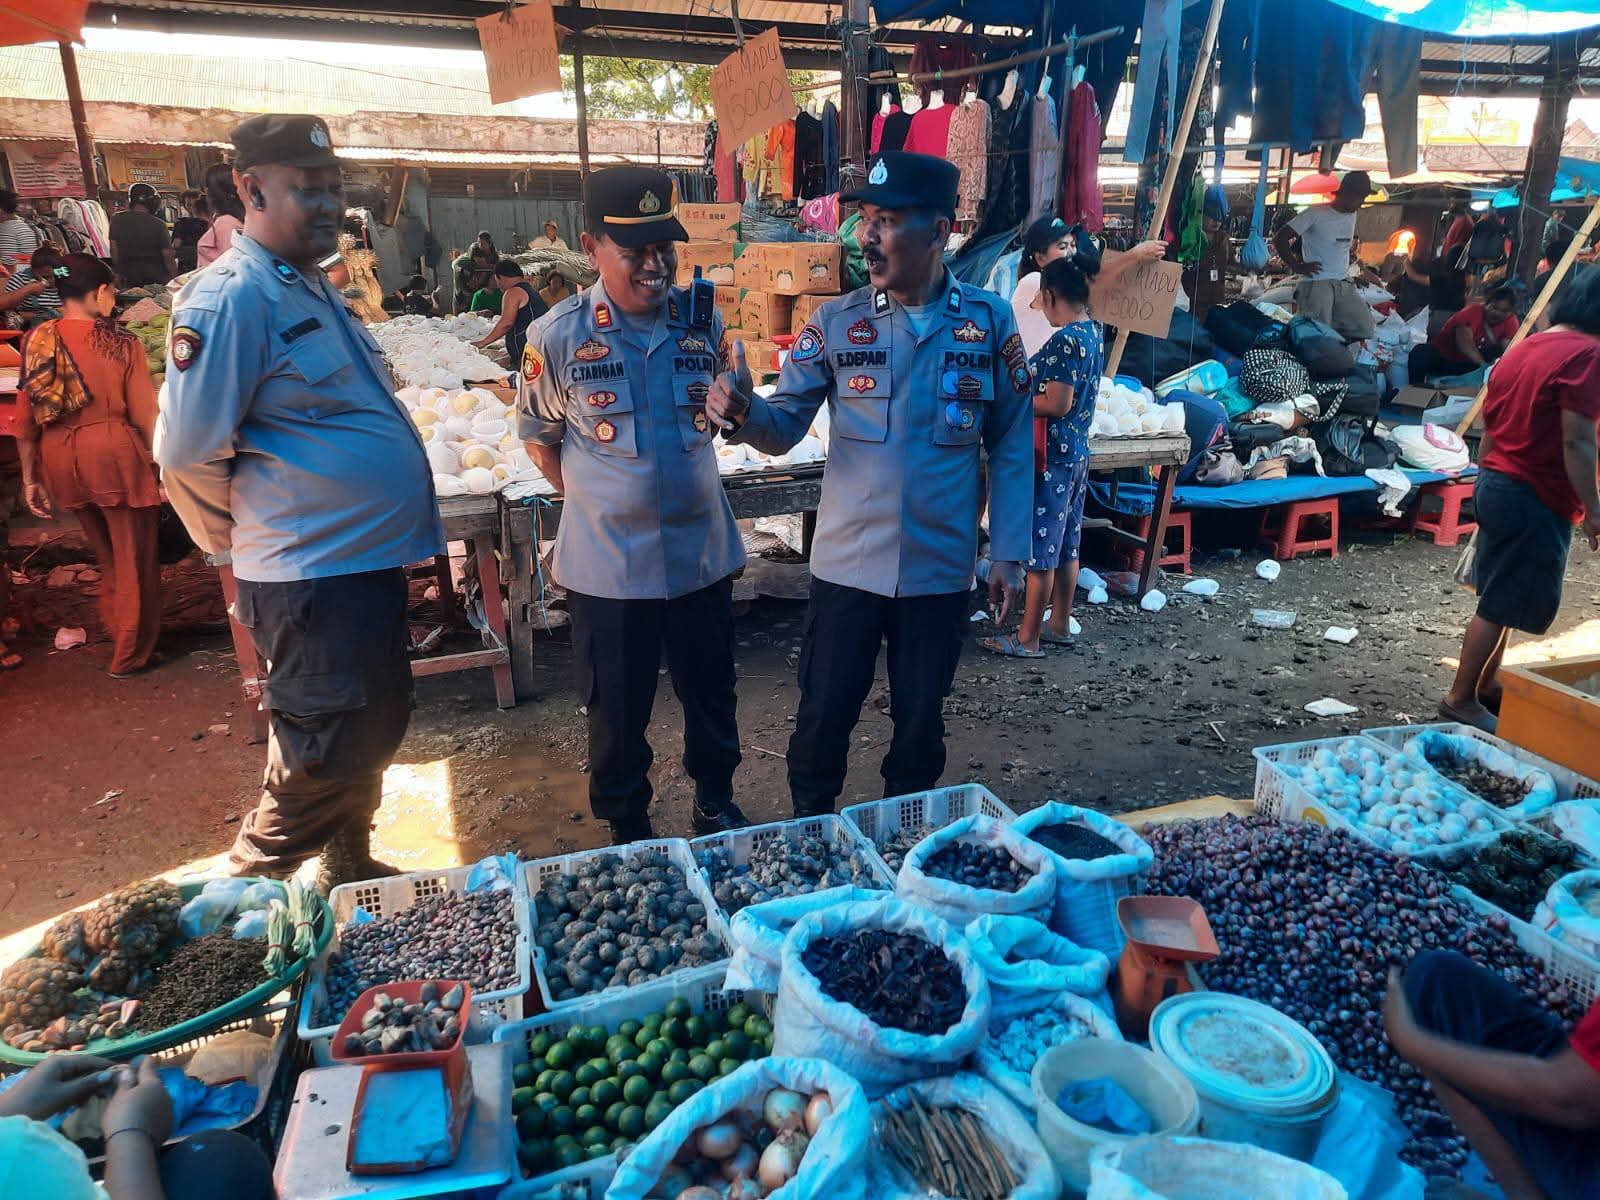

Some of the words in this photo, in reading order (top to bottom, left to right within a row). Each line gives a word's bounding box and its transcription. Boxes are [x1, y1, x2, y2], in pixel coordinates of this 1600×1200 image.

[740, 40, 778, 78] MADU
[1136, 263, 1178, 294] MADU
[674, 356, 712, 373] POLRI
[836, 350, 888, 368] E.DEPARI
[944, 351, 991, 369] POLRI
[571, 360, 625, 382] C.TARIGAN
